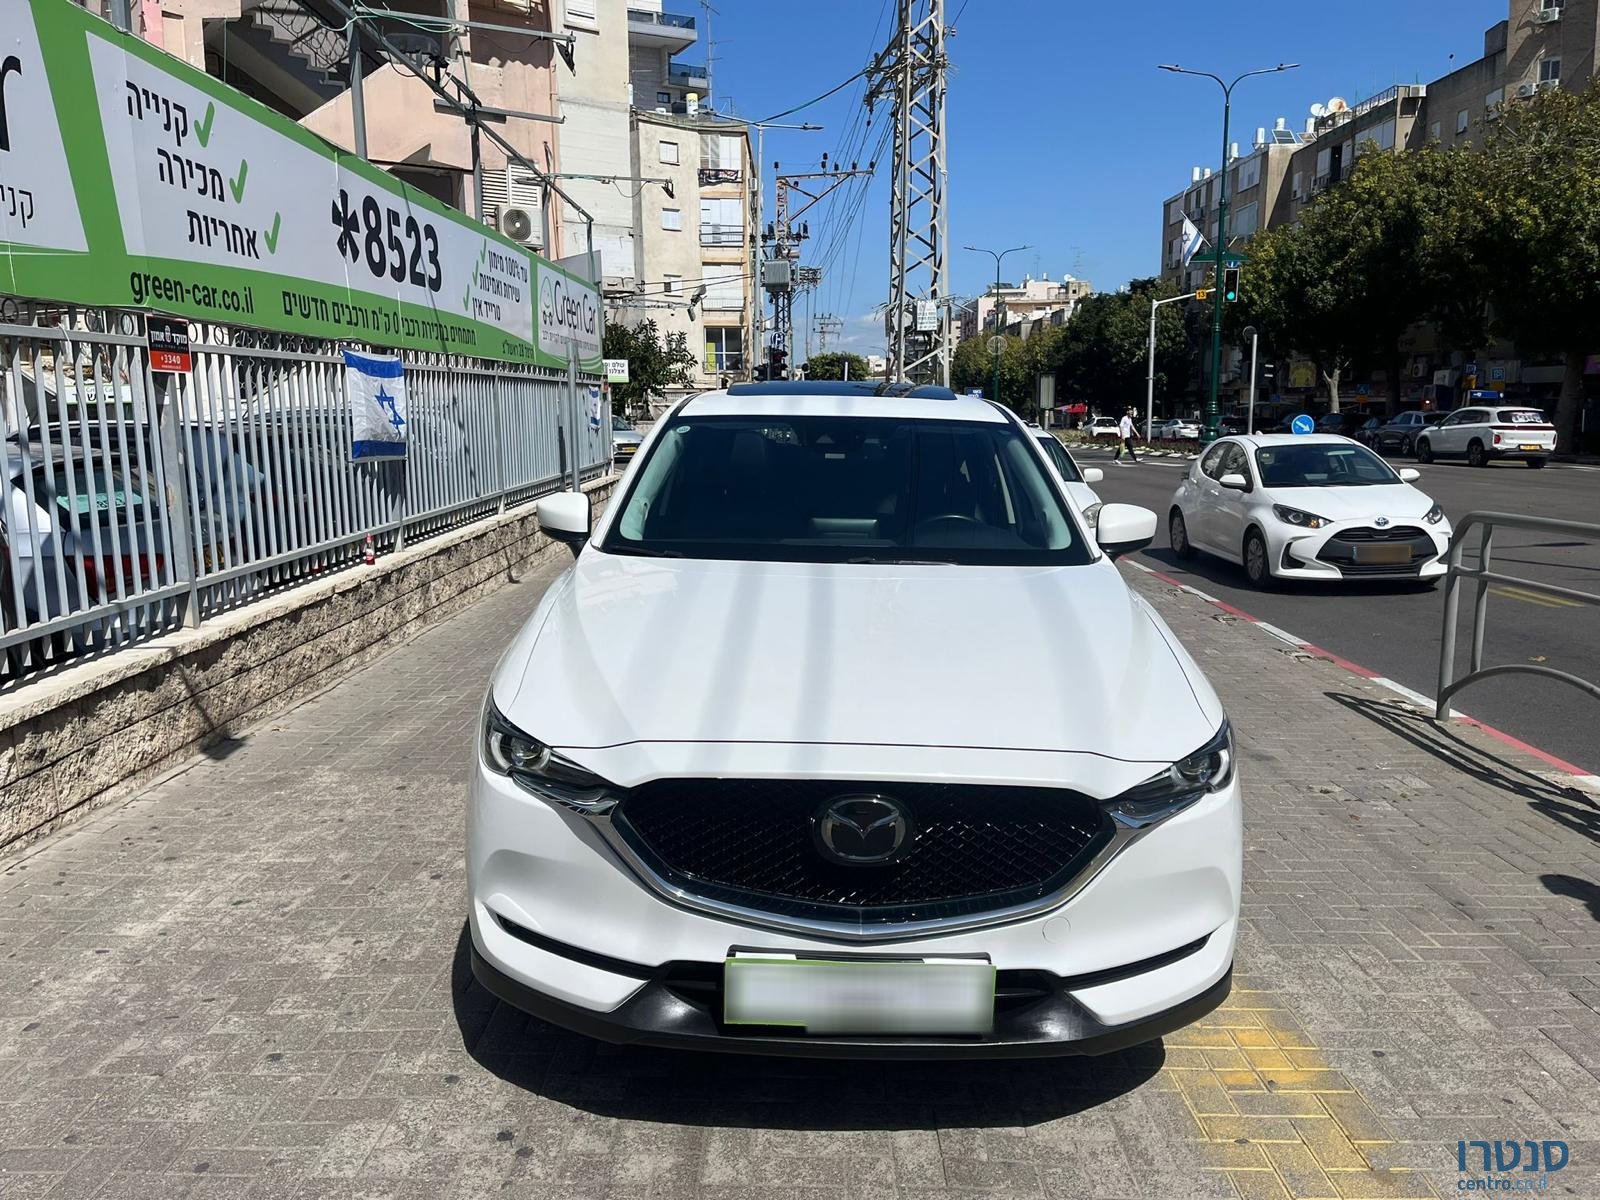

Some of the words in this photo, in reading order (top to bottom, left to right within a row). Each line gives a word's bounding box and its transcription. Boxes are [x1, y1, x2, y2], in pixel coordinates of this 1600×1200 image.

[126, 80, 188, 147] קנייה
[157, 147, 225, 203] מכירה
[186, 209, 260, 260] אחריות
[130, 271, 254, 314] green-car.co.il
[282, 290, 329, 322] חדשים
[331, 301, 370, 329] ורכבים
[401, 317, 420, 338] רכבי
[422, 320, 449, 342] במכירות
[449, 325, 477, 346] מתמחים
